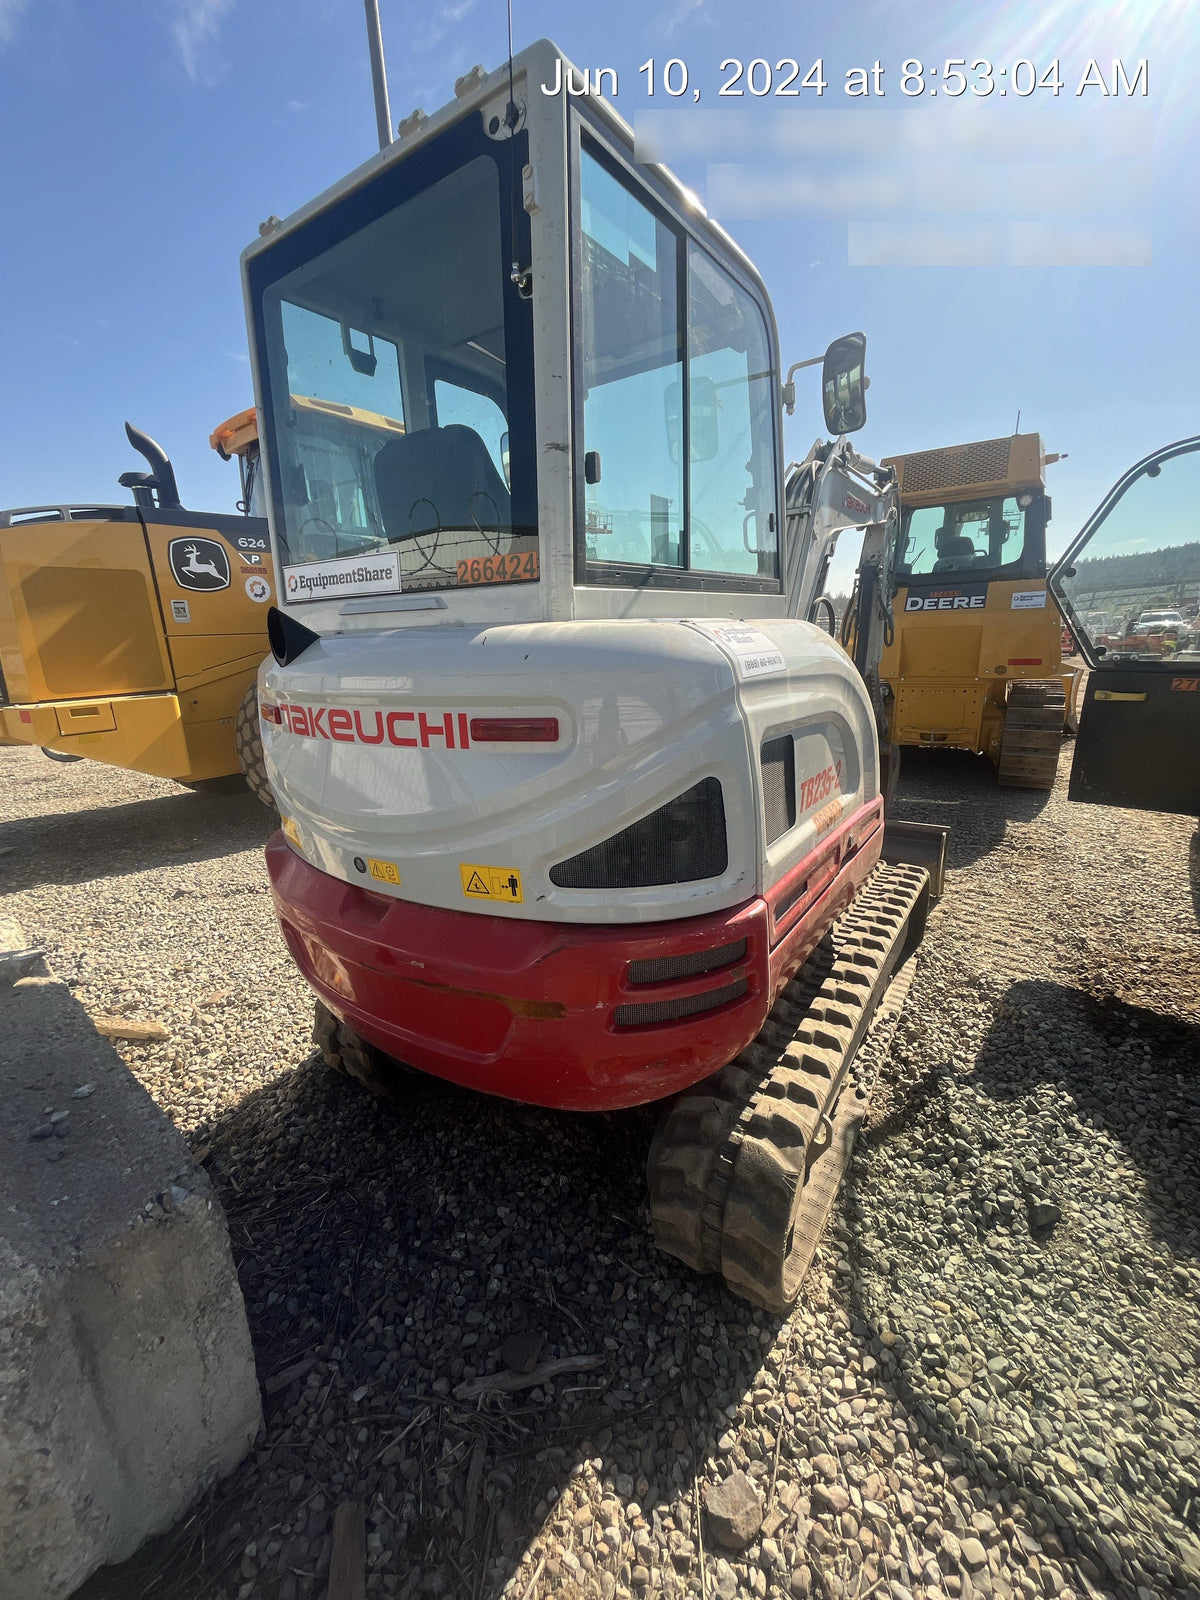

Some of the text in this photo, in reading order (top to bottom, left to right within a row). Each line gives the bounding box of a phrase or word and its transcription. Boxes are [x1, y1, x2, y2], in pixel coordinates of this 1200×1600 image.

[238, 537, 266, 548] 624
[251, 555, 260, 564] P
[458, 553, 536, 584] 266424
[299, 567, 393, 592] EquipmentShare
[905, 595, 985, 611] DEERE
[1173, 678, 1200, 690] 27
[279, 703, 470, 750] TAKEUCHI
[800, 759, 842, 815] TB235-2
